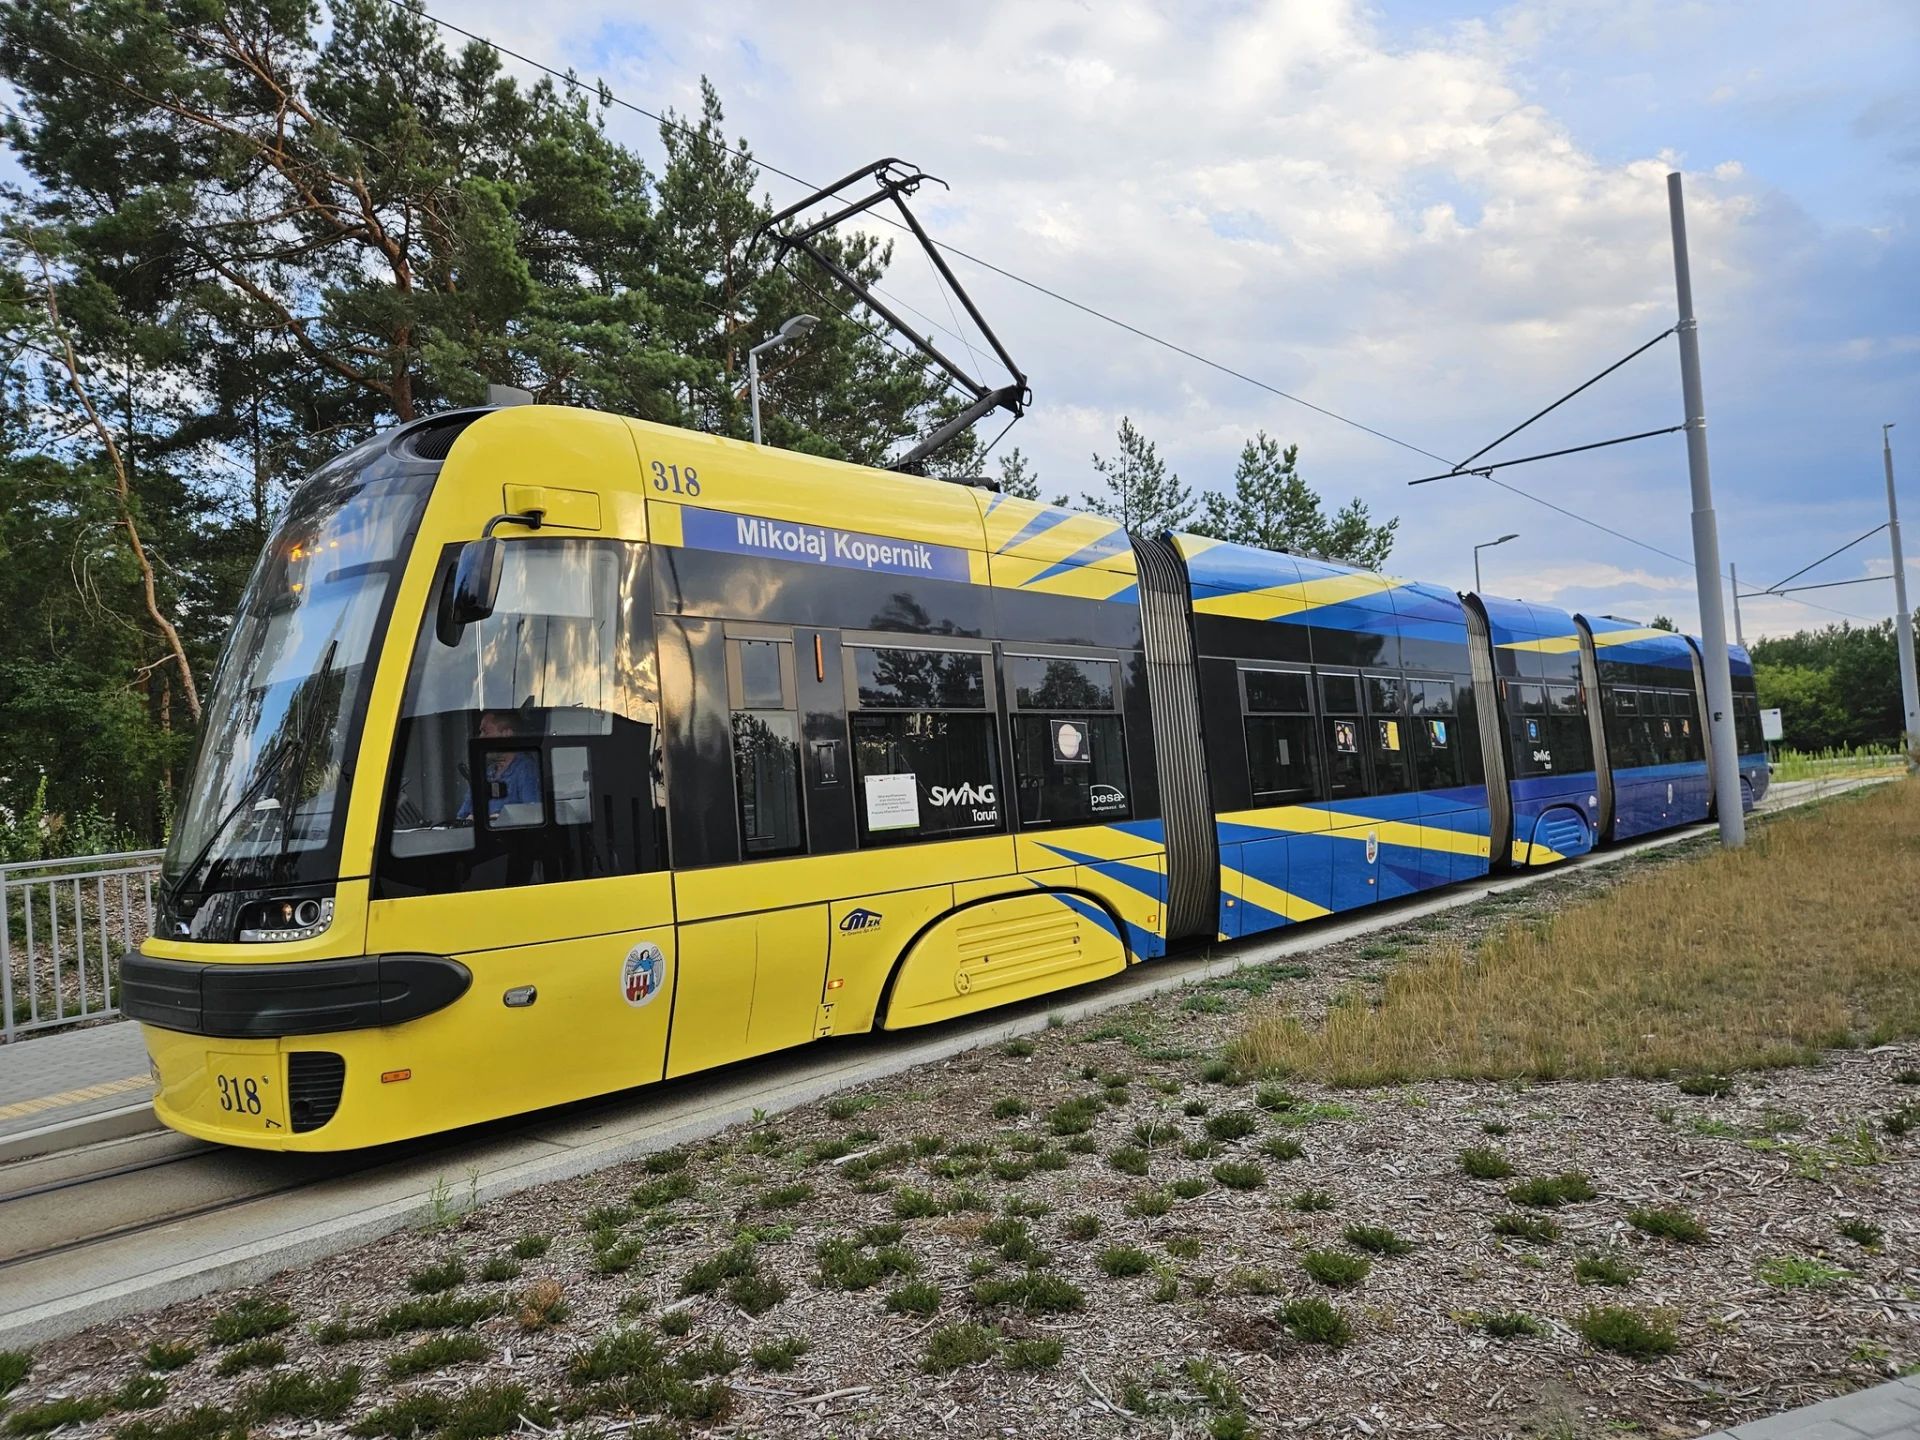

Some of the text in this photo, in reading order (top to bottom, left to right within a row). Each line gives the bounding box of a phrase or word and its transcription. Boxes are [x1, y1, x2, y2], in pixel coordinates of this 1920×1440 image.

[651, 460, 701, 497] 318
[736, 517, 933, 570] Mikołaj Kopernik
[971, 806, 998, 822] Toruń
[1091, 793, 1122, 806] pesa
[217, 1074, 262, 1116] 318
